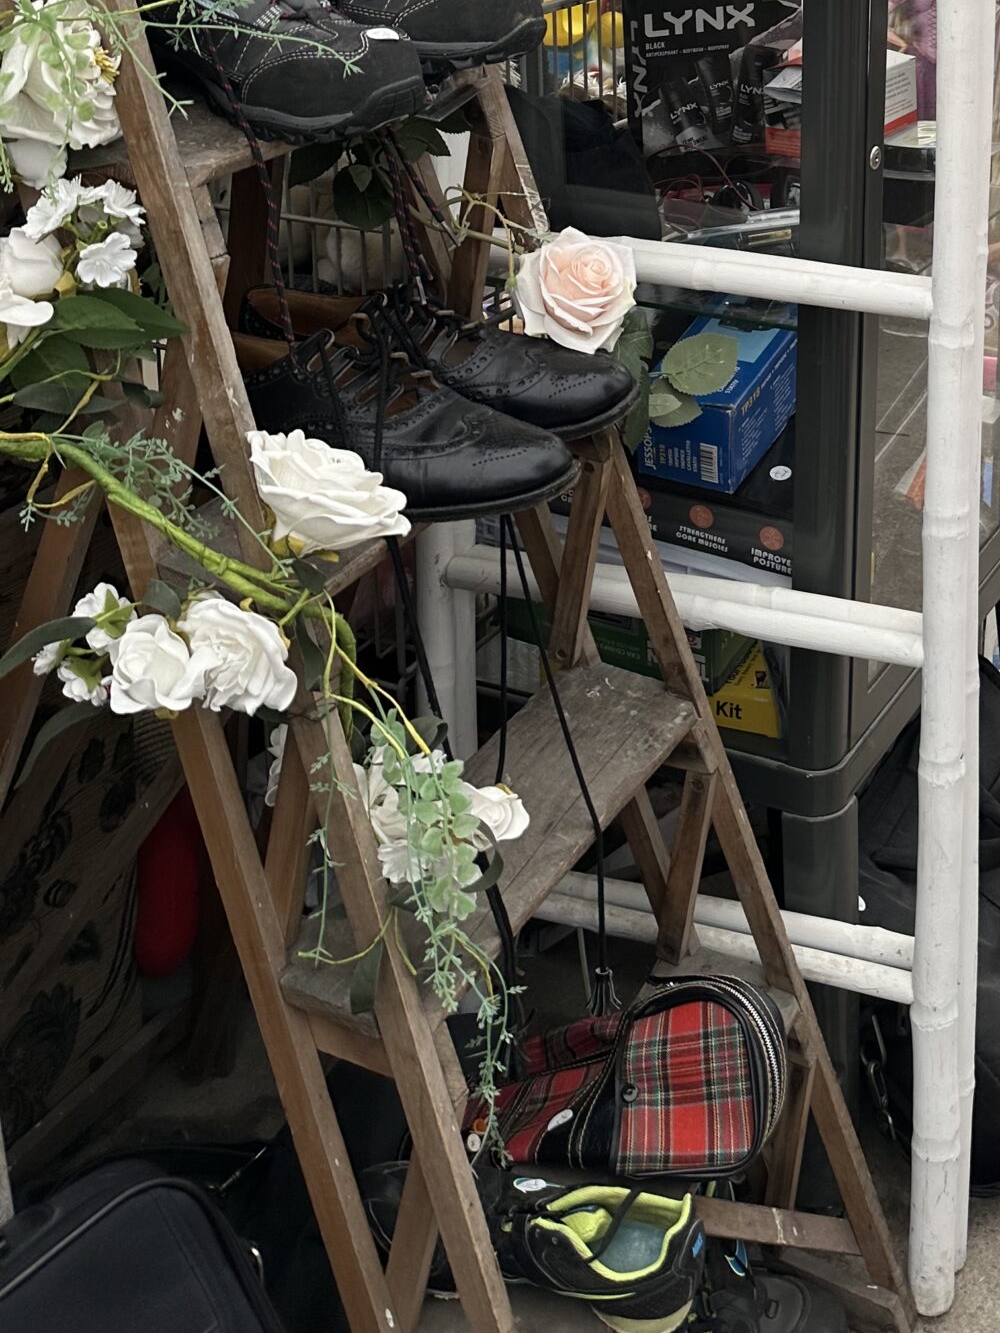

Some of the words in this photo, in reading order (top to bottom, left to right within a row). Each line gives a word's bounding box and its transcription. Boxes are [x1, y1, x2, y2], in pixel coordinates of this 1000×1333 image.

[643, 2, 756, 38] LYNX
[645, 41, 666, 50] BLACK
[630, 20, 648, 118] LYNX
[709, 80, 730, 90] LYNX
[670, 102, 698, 120] LYNX
[676, 531, 697, 543] CORE
[697, 538, 729, 553] MUSCLES
[679, 525, 726, 544] STRENGTHENS
[753, 556, 792, 574] POSTURE
[716, 700, 742, 719] Kit
